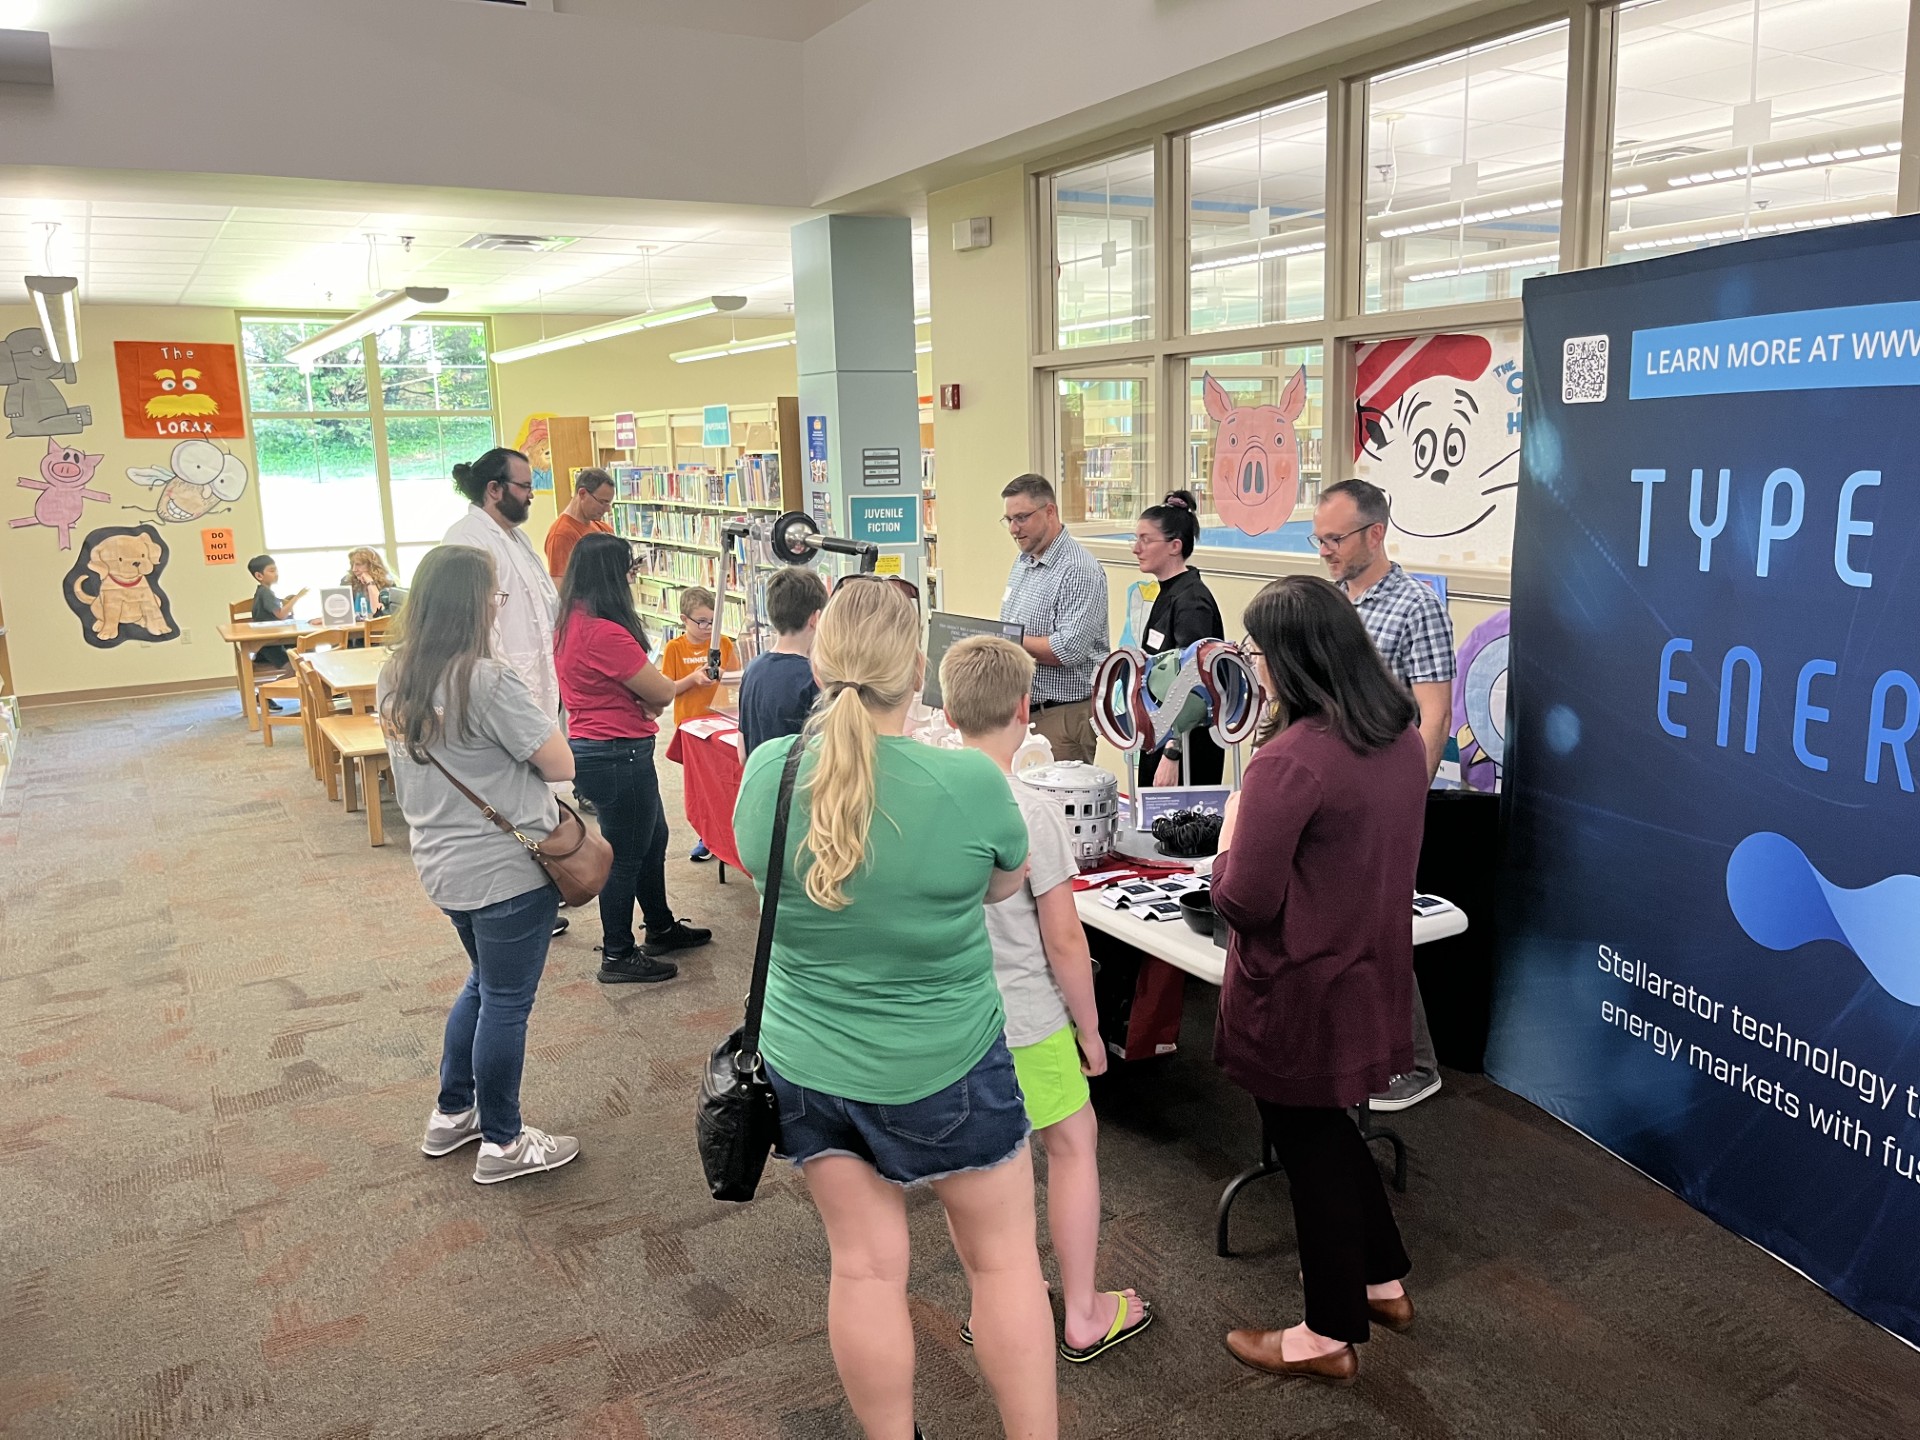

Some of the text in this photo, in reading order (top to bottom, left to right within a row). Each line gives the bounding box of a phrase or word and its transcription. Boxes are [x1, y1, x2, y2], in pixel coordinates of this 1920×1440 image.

[161, 347, 194, 360] The
[1647, 344, 1719, 375] LEARN
[1727, 337, 1802, 368] MORE
[1808, 334, 1845, 363] AT
[1493, 360, 1516, 377] THE
[156, 421, 212, 435] LORAX
[864, 508, 903, 518] JUVENILE
[867, 522, 900, 532] FICTION
[1630, 467, 1882, 588] TYPE
[1597, 944, 1725, 1023] Stellarator
[1731, 1005, 1897, 1110] technology
[1601, 1000, 1683, 1062] energy
[1689, 1044, 1800, 1119] markets
[1808, 1102, 1872, 1157] with
